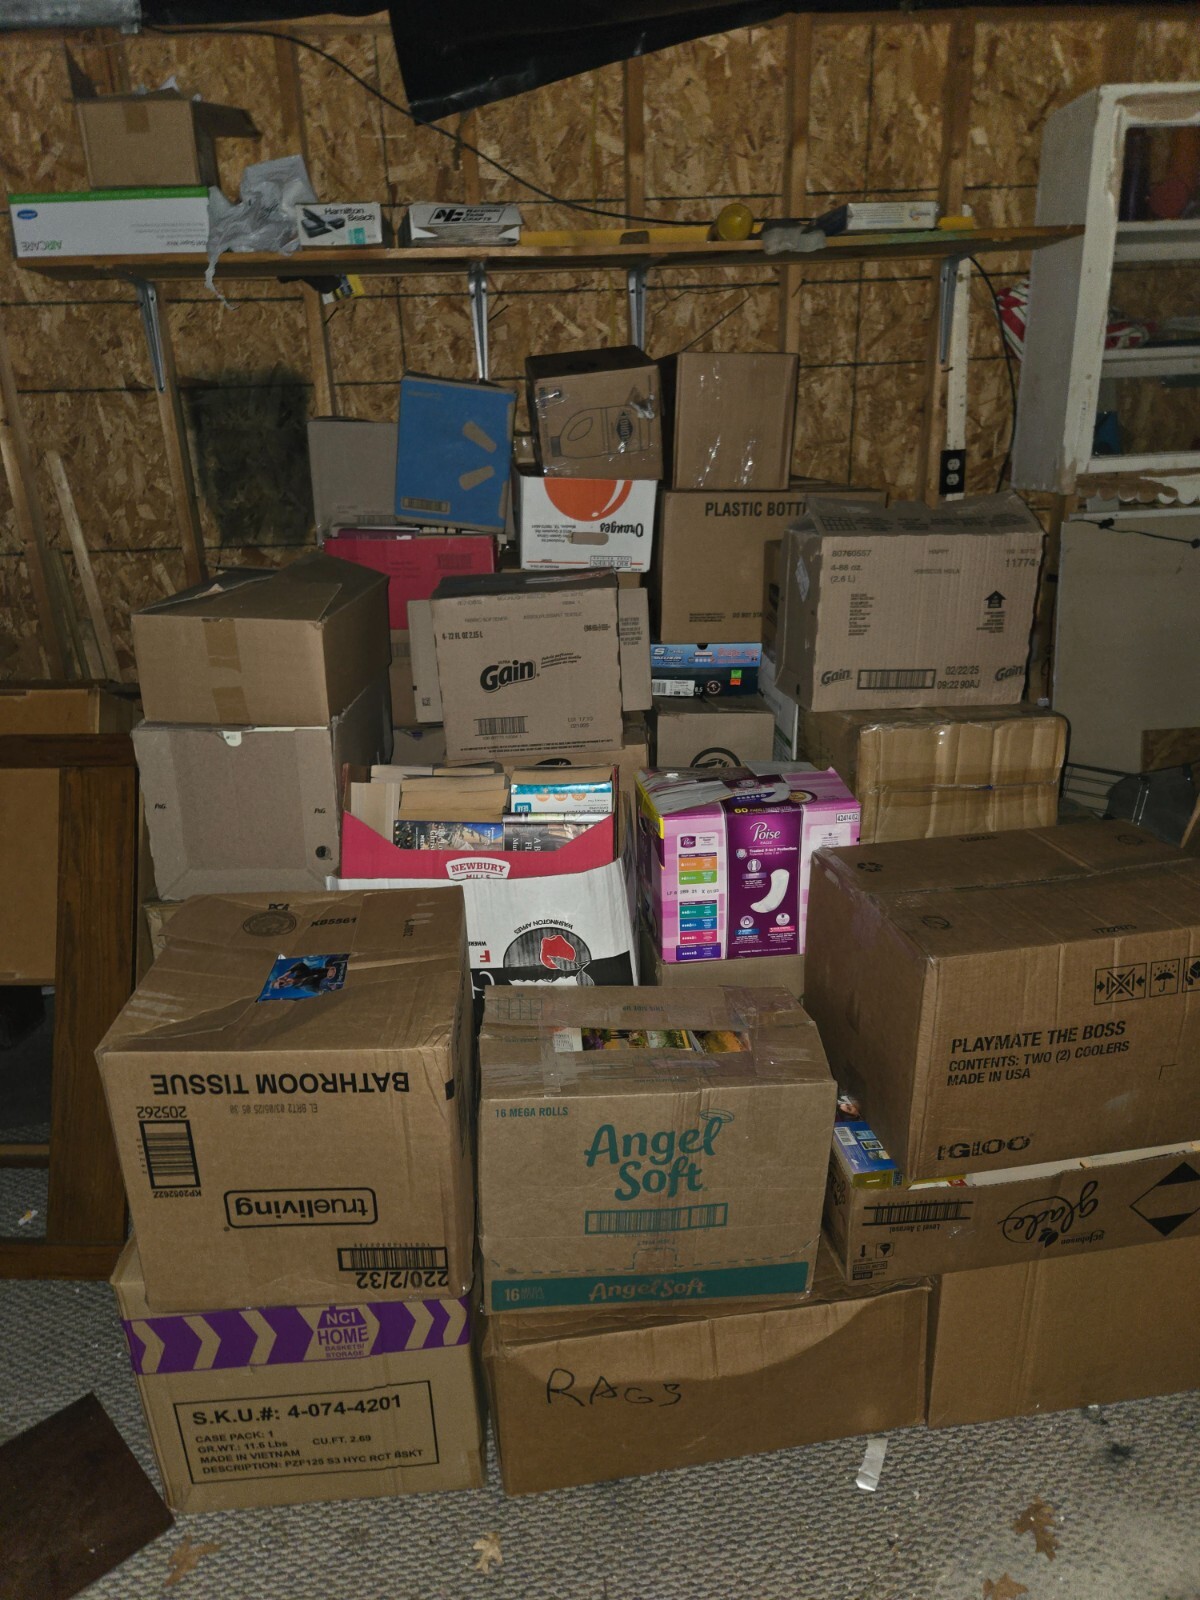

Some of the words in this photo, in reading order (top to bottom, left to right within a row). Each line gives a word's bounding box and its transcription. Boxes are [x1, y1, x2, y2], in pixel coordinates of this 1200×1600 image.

[324, 207, 365, 215] Hamilton
[347, 214, 376, 222] Beach
[704, 502, 763, 517] PLASTIC
[600, 522, 644, 538] Oranges
[480, 660, 536, 693] Gain
[820, 669, 850, 685] Gain
[994, 665, 1024, 681] Gain
[749, 822, 781, 841] Poise
[450, 862, 506, 873] NEWBURY
[513, 922, 532, 934] APPLES
[532, 919, 574, 930] WASHINGTON
[951, 1032, 1043, 1054] PLAYMATE
[1047, 1027, 1079, 1044] THE
[1082, 1020, 1127, 1040] BOSS
[949, 1056, 1020, 1072] CONTENTS:
[1024, 1052, 1052, 1065] TWO
[1055, 1049, 1072, 1063] (2)
[1074, 1040, 1130, 1058] COOLERS
[151, 1074, 249, 1096] TISSUE
[256, 1072, 410, 1095] BATHROOM
[947, 1073, 985, 1086] MADE
[988, 1071, 1002, 1082] IN
[1005, 1068, 1031, 1080] USA
[136, 1105, 188, 1119] 205262
[495, 1108, 507, 1118] 16
[509, 1107, 536, 1118] MEGA
[538, 1106, 569, 1117] ROLLS
[583, 1116, 724, 1168] Angel
[614, 1155, 704, 1201] Soft
[235, 1198, 369, 1219] trueliving
[1006, 1180, 1099, 1241] glade
[355, 1271, 449, 1289] 220/2/32
[588, 1276, 660, 1301] Angel
[660, 1276, 707, 1298] Soft
[504, 1286, 520, 1302] 16
[326, 1311, 357, 1325] NCI
[317, 1326, 370, 1346] HOME
[192, 1405, 281, 1426] S.K.U.#:
[287, 1394, 402, 1419] 4-074-4201
[195, 1434, 227, 1444] CASE
[229, 1431, 265, 1442] PACK:
[269, 1430, 274, 1439] 1
[200, 1454, 233, 1465] MADE
[236, 1452, 248, 1462] IN
[249, 1449, 301, 1461] VIETNAM
[202, 1461, 283, 1475] DESCRIPTION:
[369, 1451, 392, 1462] RCT
